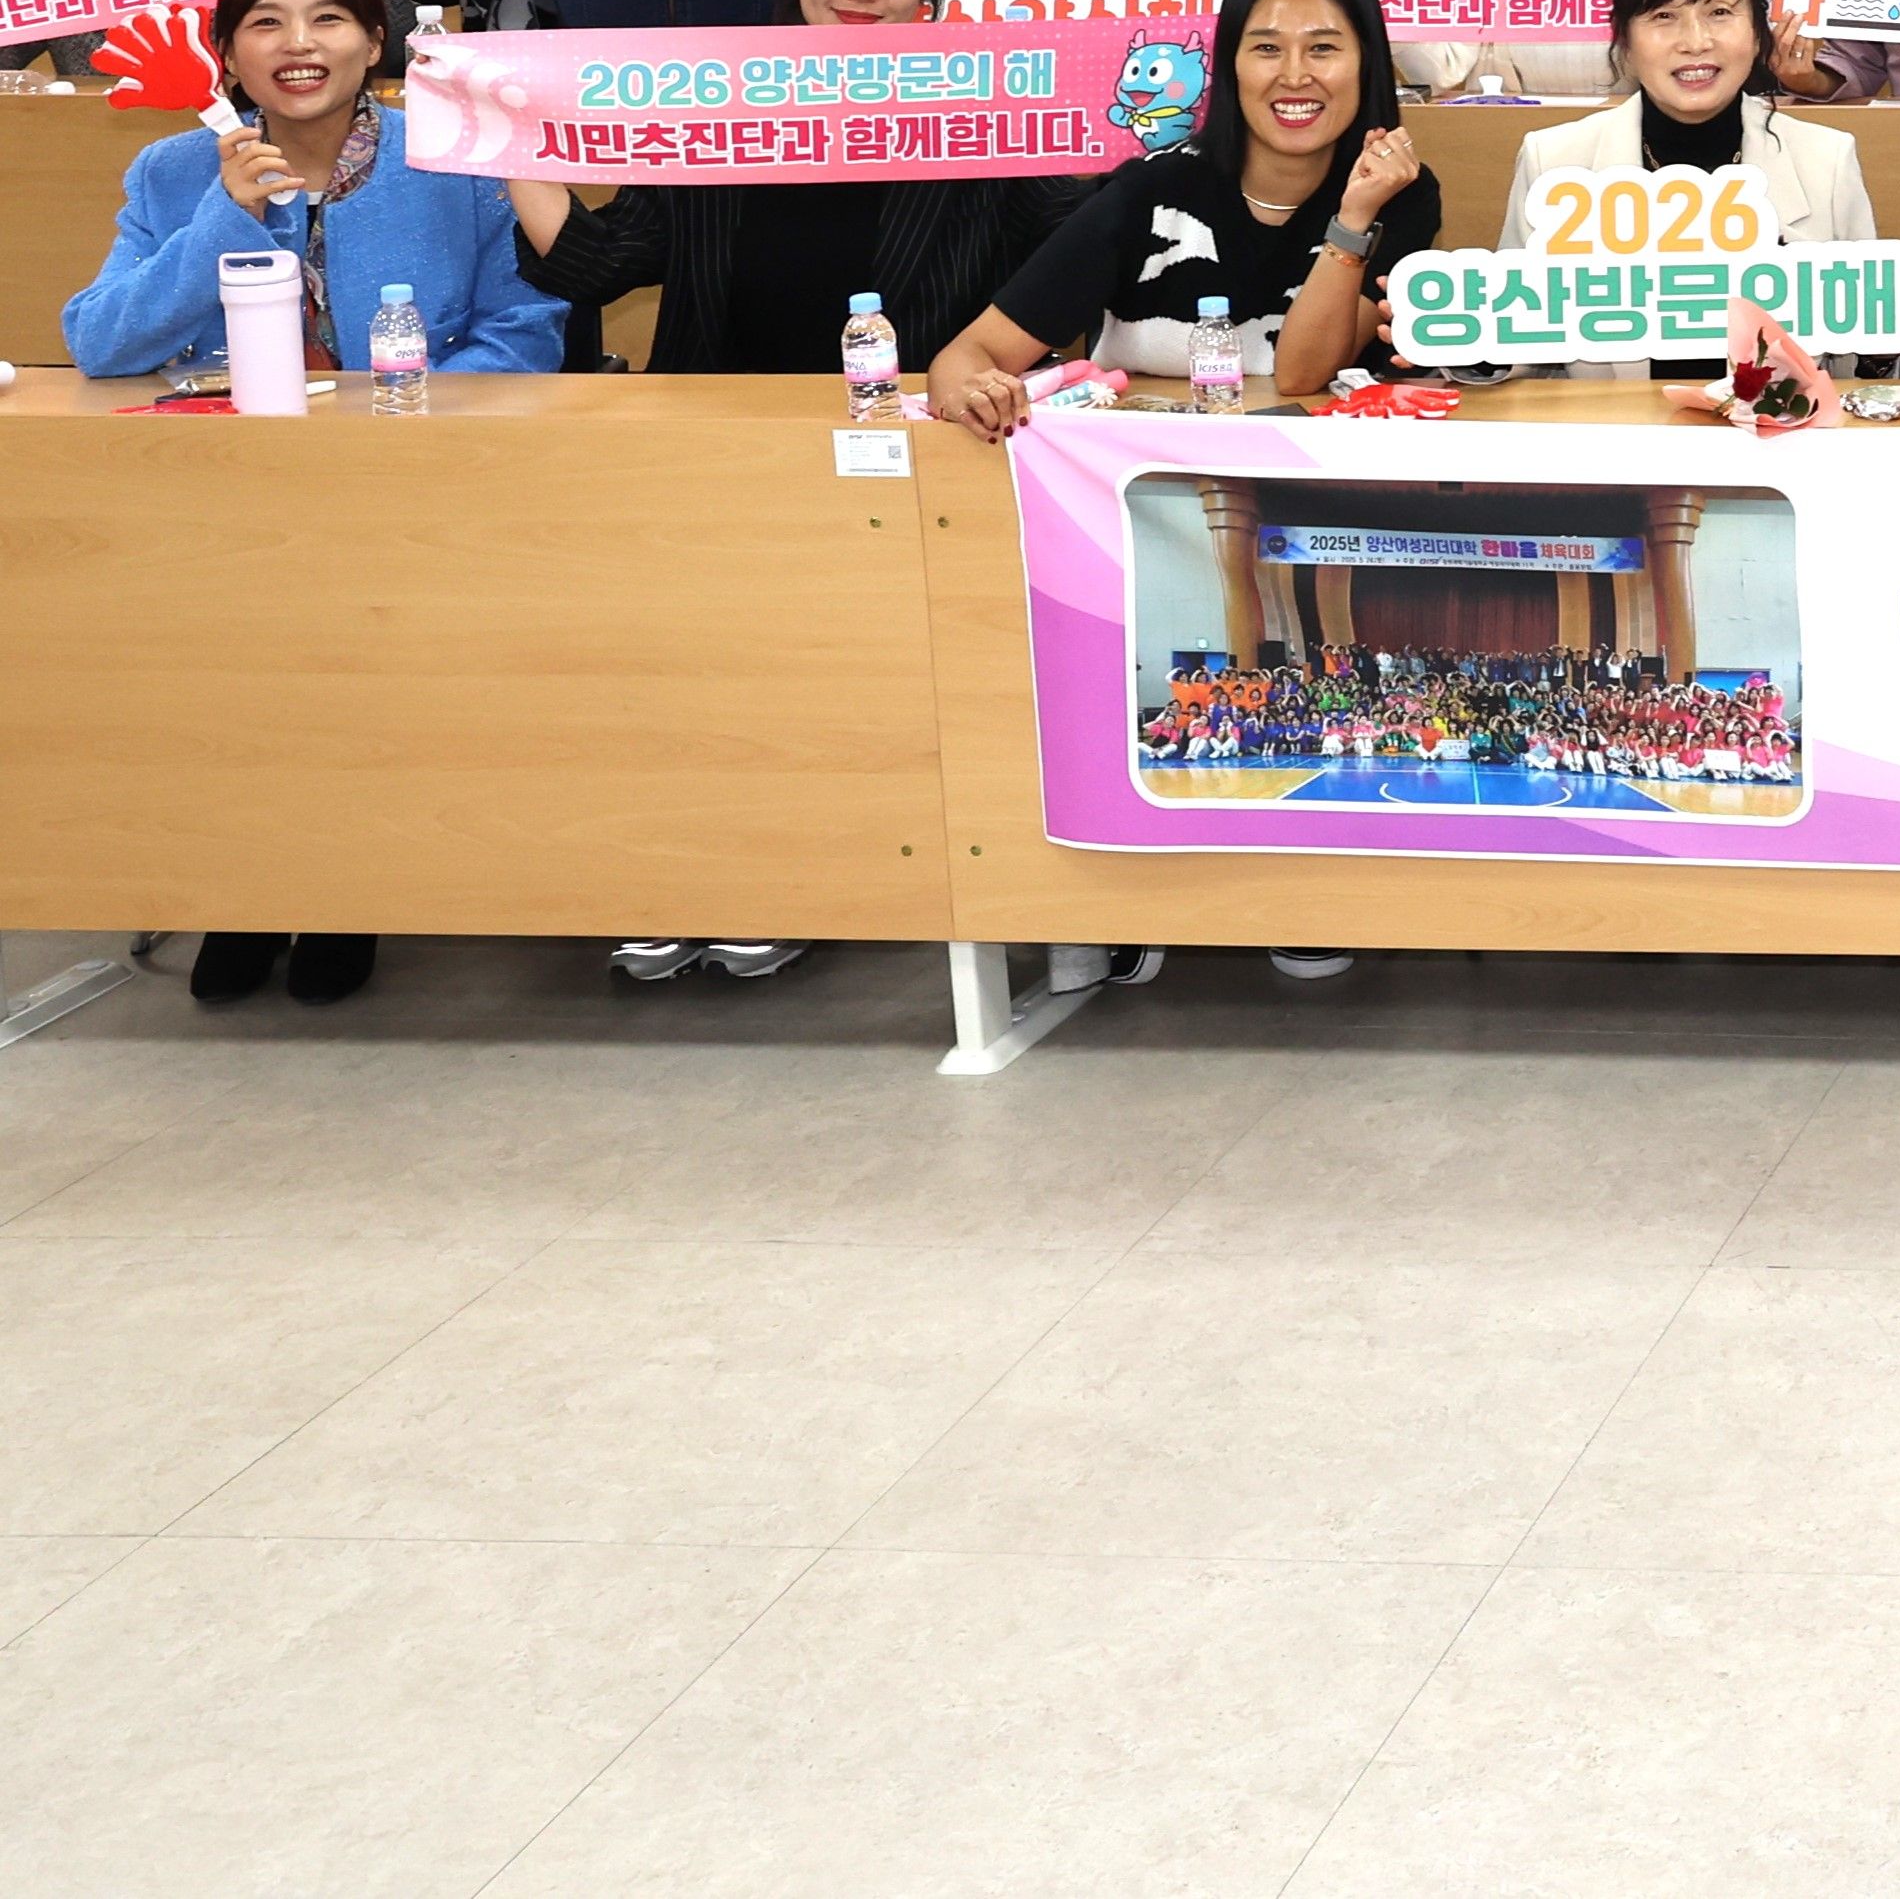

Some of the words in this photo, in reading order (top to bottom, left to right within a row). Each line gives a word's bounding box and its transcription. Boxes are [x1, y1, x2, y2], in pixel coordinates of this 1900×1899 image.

[576, 61, 730, 110] 2026
[742, 51, 994, 105] 양산방문의
[1007, 49, 1054, 98] 해
[536, 117, 830, 167] 시민추진단과
[845, 110, 1101, 161] 함께합니다.
[1546, 179, 1759, 254] 2026
[1408, 260, 1896, 346] 양산방문의해
[1310, 535, 1361, 553] 2025년
[1366, 536, 1477, 556] 양산여성리더대학
[1481, 539, 1538, 559] 한마음
[1540, 543, 1595, 560] 체육대회
